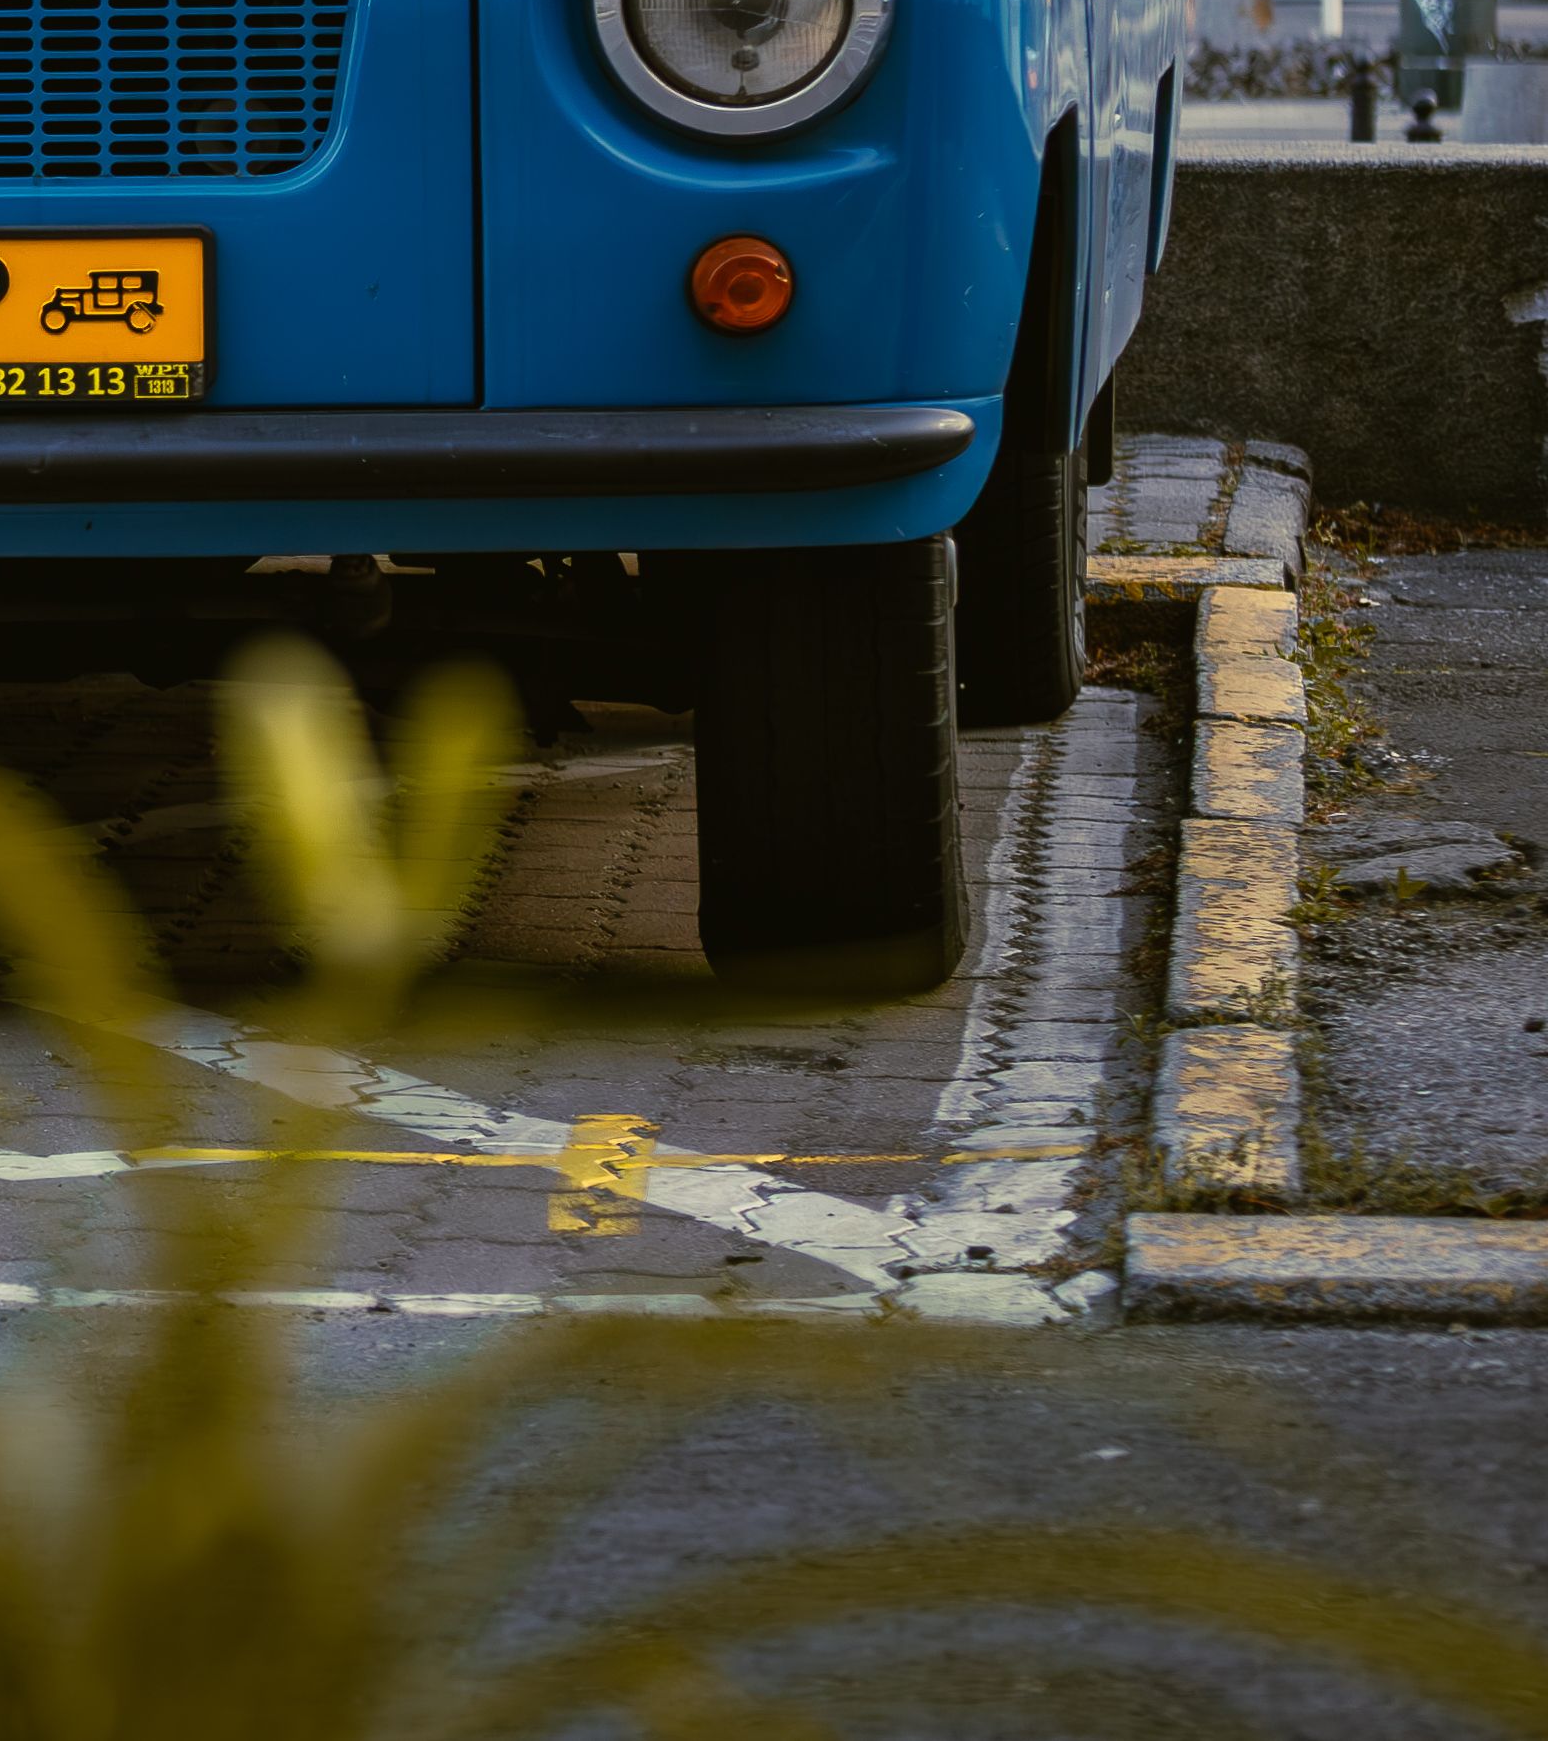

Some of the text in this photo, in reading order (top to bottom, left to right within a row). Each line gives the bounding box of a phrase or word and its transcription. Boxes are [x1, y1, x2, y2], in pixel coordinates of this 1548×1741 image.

[134, 364, 189, 376] WPT
[38, 368, 76, 396] 13
[87, 367, 125, 396] 13
[147, 379, 175, 395] 1313
